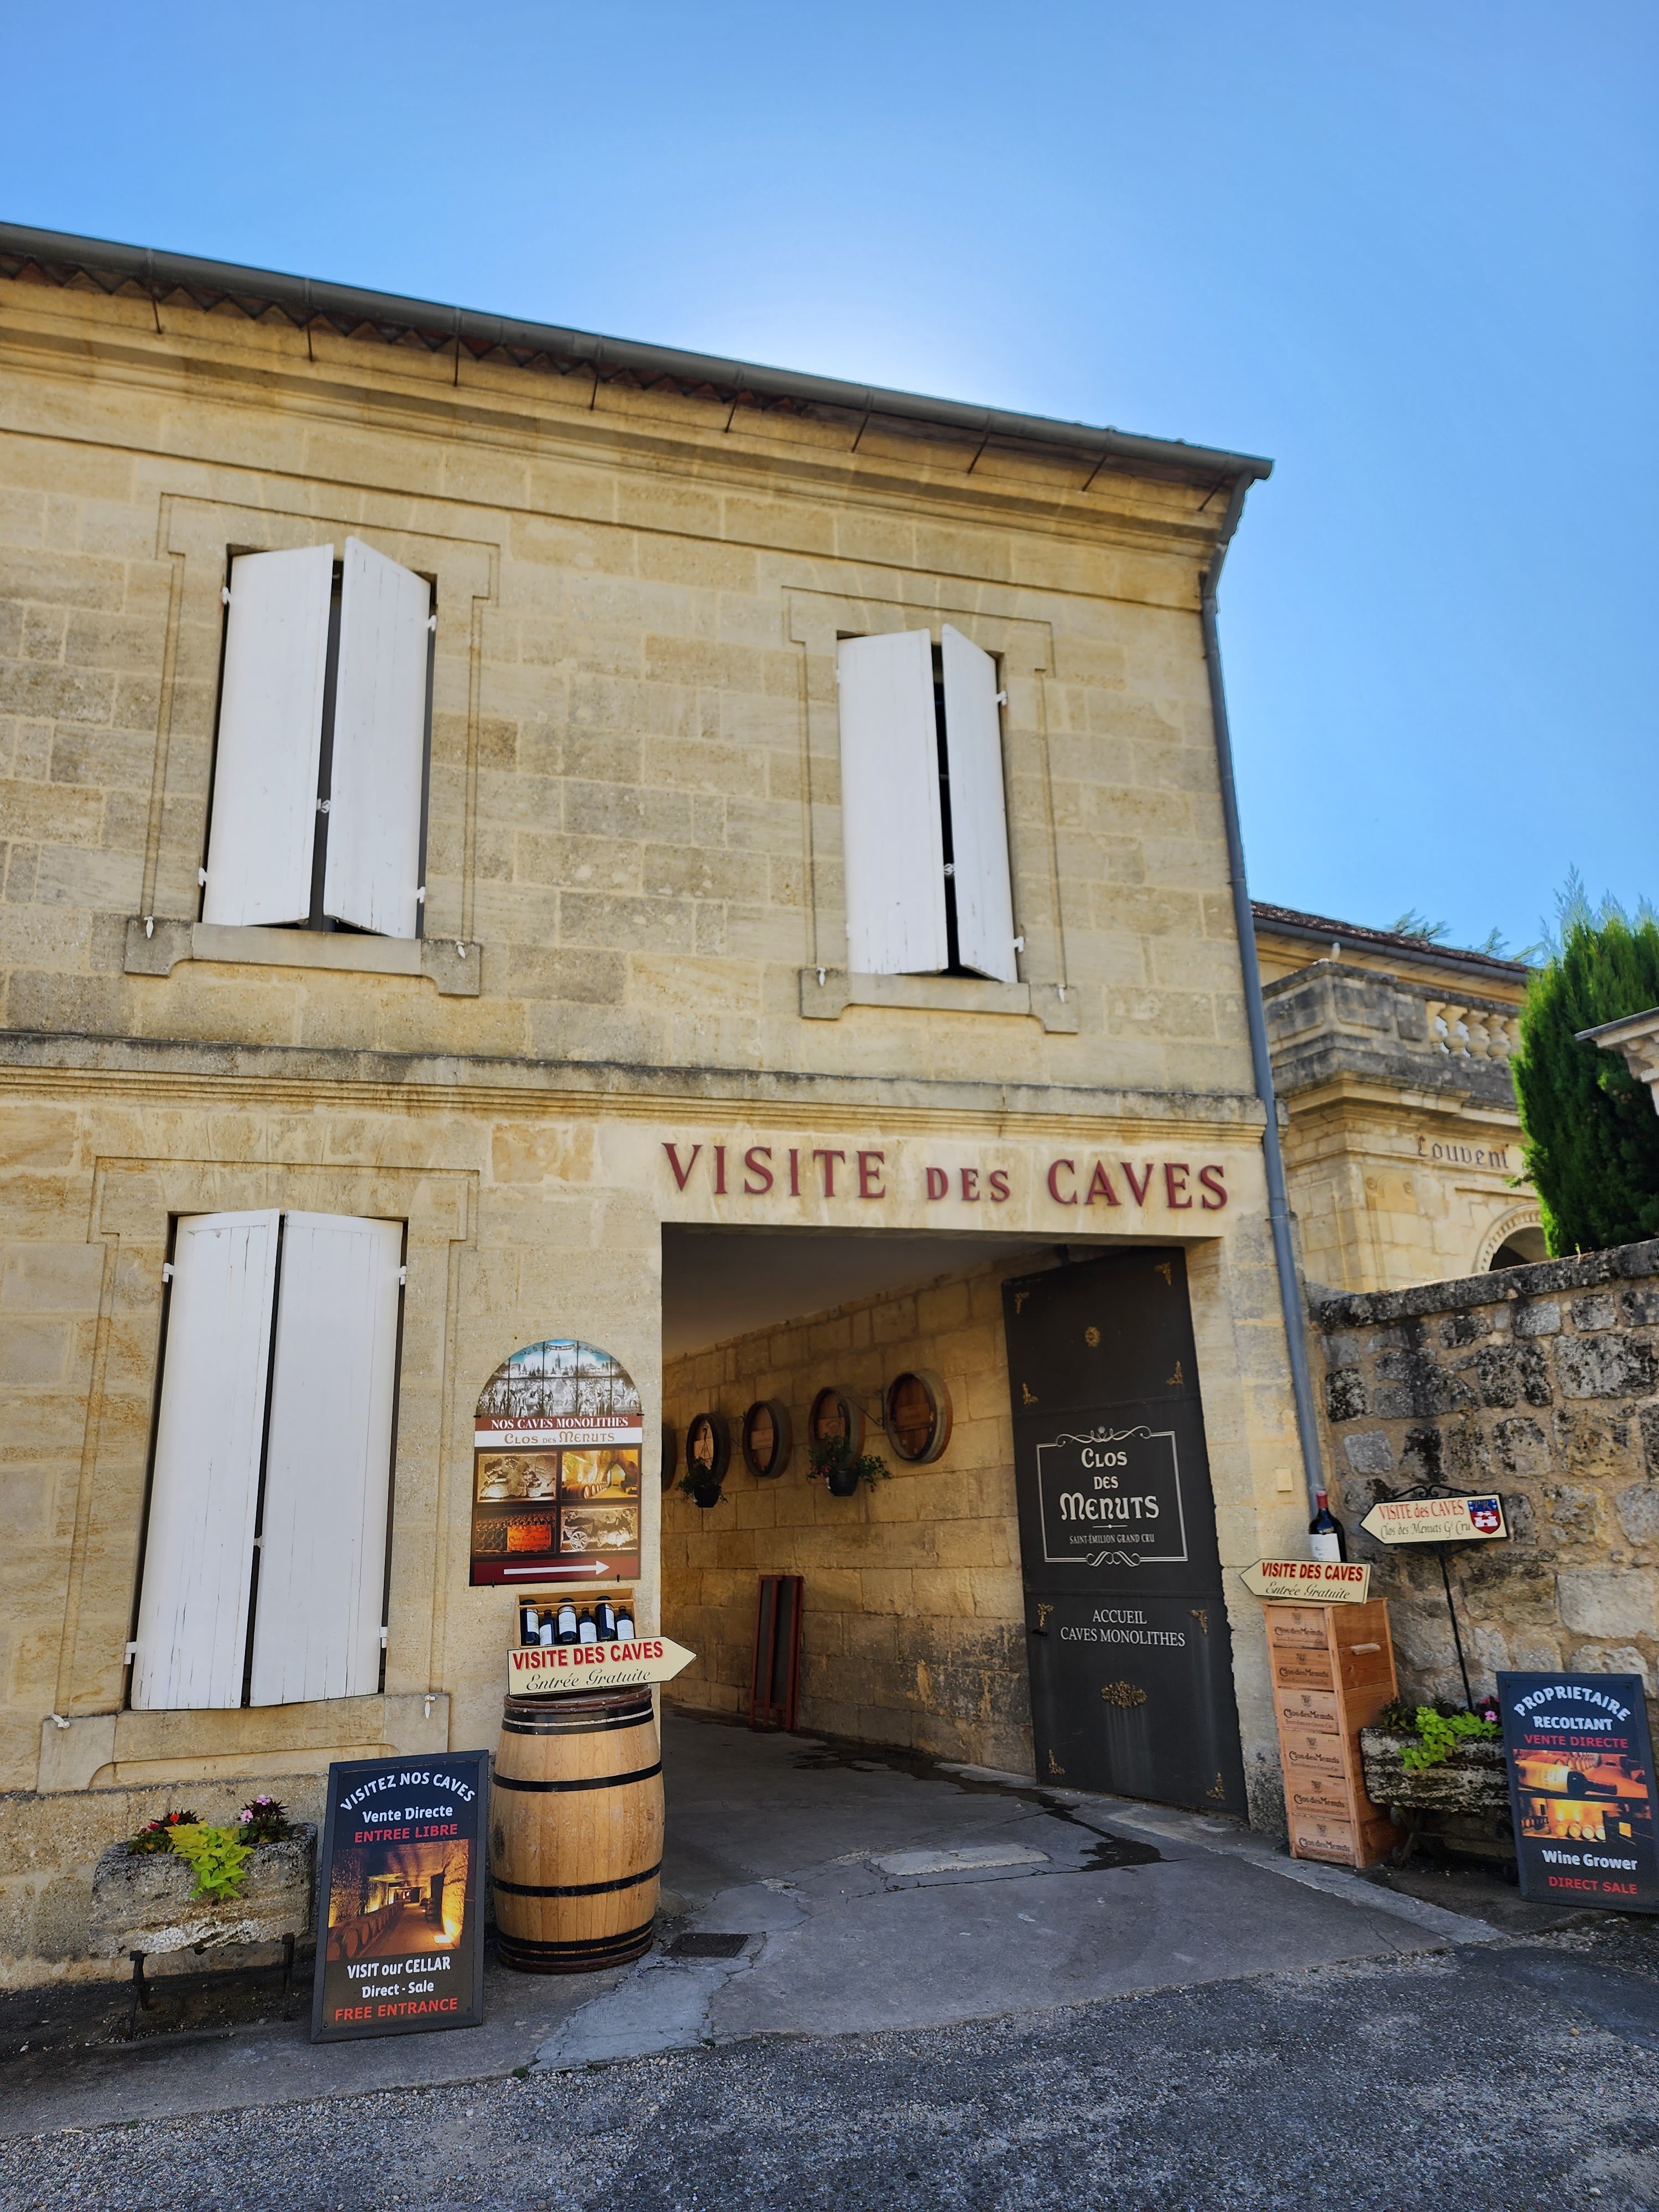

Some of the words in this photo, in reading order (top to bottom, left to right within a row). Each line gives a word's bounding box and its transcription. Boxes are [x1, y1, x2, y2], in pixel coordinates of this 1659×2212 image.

[662, 1142, 886, 1199] VISITE
[926, 1167, 1010, 1203] DES
[1048, 1159, 1229, 1210] CAVES
[491, 1419, 514, 1430] NOS
[517, 1418, 552, 1429] CAVES
[556, 1417, 628, 1428] MONOLITHES
[1379, 1504, 1412, 1520] VISITE
[1414, 1503, 1430, 1518] des
[1430, 1499, 1465, 1517] CAVES
[1117, 1534, 1140, 1543] GRAND
[1141, 1533, 1155, 1543] CRU
[1380, 1522, 1395, 1540] Clos
[1397, 1522, 1409, 1535] des
[1411, 1521, 1442, 1535] Menuts
[1455, 1520, 1471, 1535] Cru
[1262, 1562, 1297, 1578] VISITE
[1300, 1563, 1322, 1579] DES
[1325, 1565, 1363, 1582] CAVES
[1265, 1581, 1301, 1596] Entrée
[1304, 1583, 1350, 1599] Gratuite
[1092, 1609, 1147, 1625] ACCUEIL
[1060, 1626, 1098, 1643] CAVES
[1099, 1629, 1186, 1647] MONOLITHES
[512, 1648, 568, 1671] VISITE
[573, 1645, 606, 1665] DES
[610, 1641, 664, 1662] CAVES
[526, 1672, 580, 1691] Entrée
[586, 1668, 651, 1686] Gratuite
[1514, 1686, 1631, 1721] PROPRIETAIRE
[1533, 1716, 1613, 1730] RECOLTANT
[1524, 1734, 1567, 1745] VENTE
[1569, 1736, 1629, 1749] DIRECTE
[340, 1775, 397, 1811] VISITEZ
[399, 1772, 430, 1786] NOS
[433, 1773, 476, 1802] CAVES
[362, 1809, 401, 1823] Vente
[404, 1805, 453, 1820] Directe
[354, 1827, 410, 1844] ENTREE
[415, 1823, 458, 1838] LIBRE
[1541, 1849, 1580, 1865] Wine
[1583, 1853, 1638, 1870] Grower
[1548, 1876, 1598, 1891] DIRECT
[1602, 1881, 1637, 1895] SALE
[347, 1962, 379, 1979] VISIT
[382, 1963, 403, 1976] our
[405, 1956, 451, 1974] CELLAR
[362, 1984, 399, 1999] Direct
[408, 1979, 434, 1994] Sale
[335, 2006, 373, 2021] FREE
[378, 1997, 458, 2017] ENTRANCE
